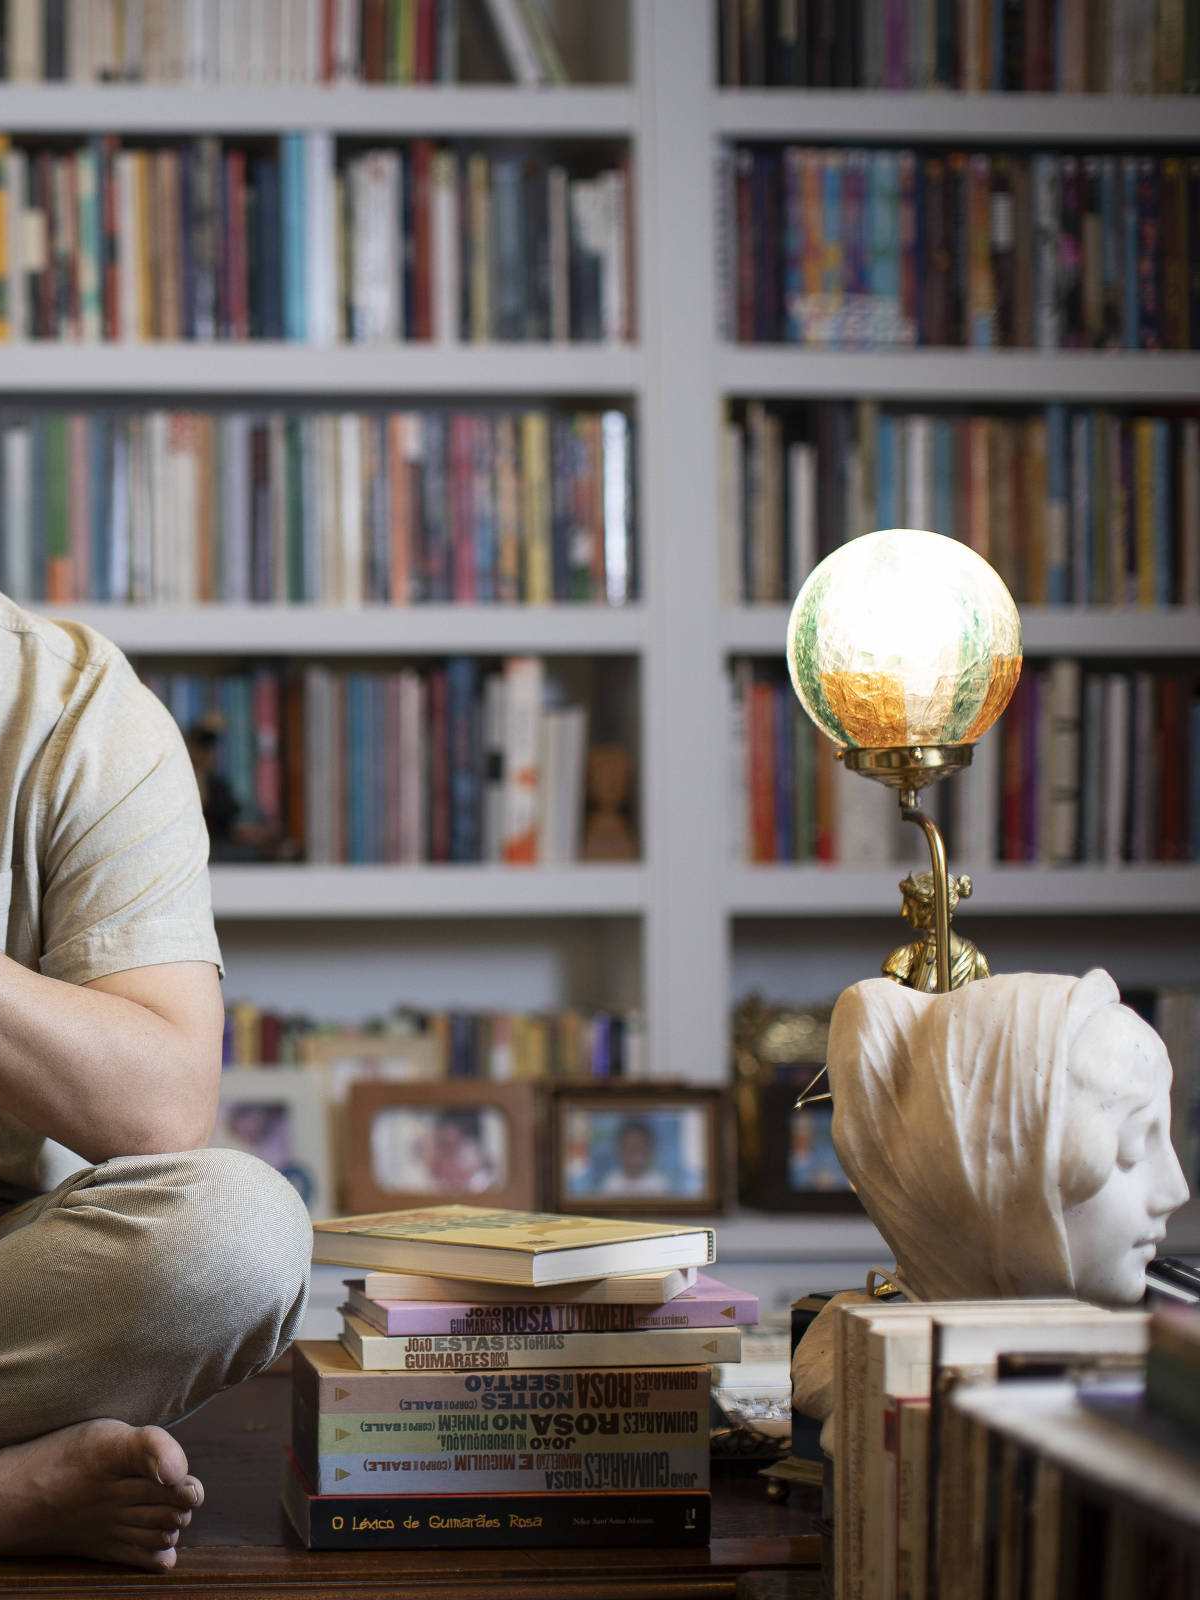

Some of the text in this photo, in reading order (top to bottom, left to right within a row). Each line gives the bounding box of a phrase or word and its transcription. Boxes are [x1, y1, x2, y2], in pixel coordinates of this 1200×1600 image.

[450, 1318, 501, 1334] GUIMARÃES
[502, 1305, 553, 1332] ROSA
[405, 1334, 565, 1353] JOÃO ESTAS ESTÓRIAS
[404, 1351, 509, 1369] GUIMARÃES ROSA
[465, 1374, 561, 1392] SERTÃO
[576, 1371, 698, 1409] GUIMARÃES ROSA
[481, 1392, 574, 1410] NOITES
[492, 1414, 528, 1431] NO
[530, 1413, 620, 1436] ROSA
[623, 1411, 698, 1434] GUIMARÃES
[530, 1437, 576, 1450] JOÃO
[454, 1454, 516, 1472] MIGUILIM
[518, 1454, 534, 1470] E
[545, 1452, 698, 1490] JOÃO GUIMARÃES ROSA
[332, 1514, 543, 1531] O Léxico de Guimarães Rosa
